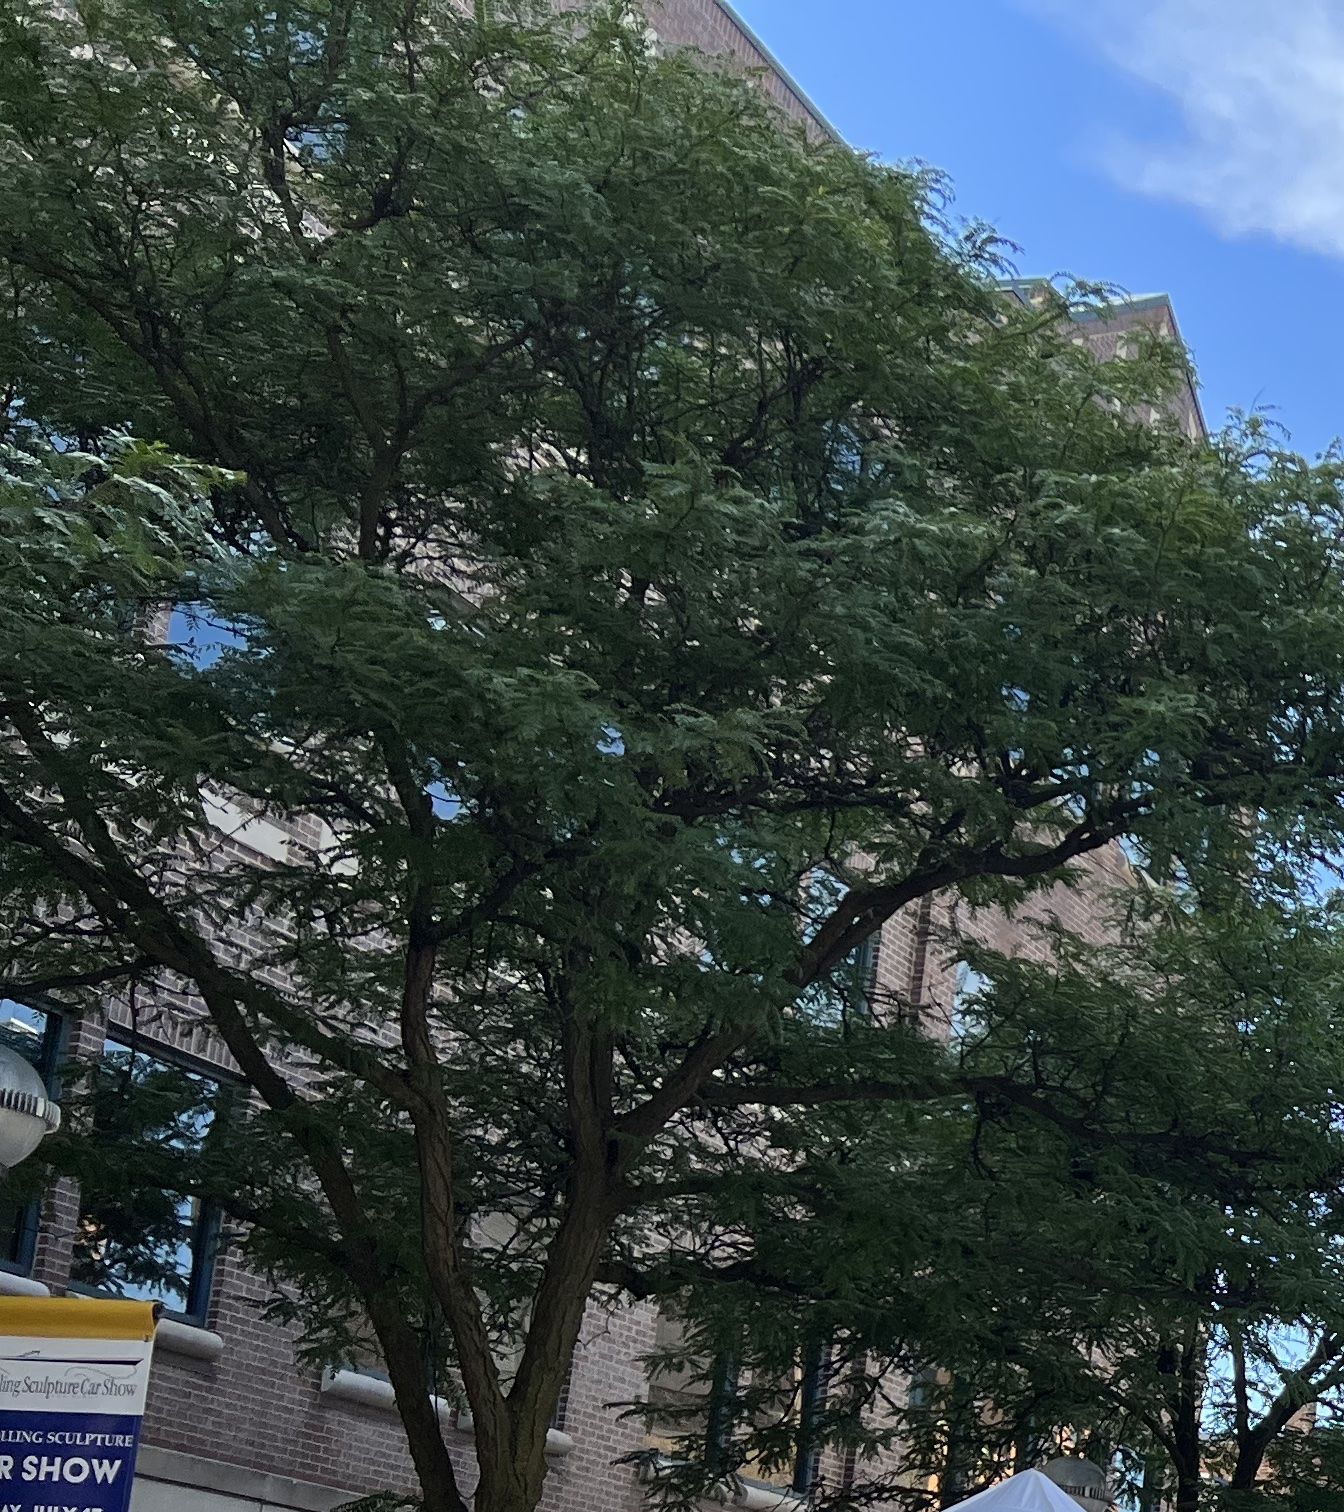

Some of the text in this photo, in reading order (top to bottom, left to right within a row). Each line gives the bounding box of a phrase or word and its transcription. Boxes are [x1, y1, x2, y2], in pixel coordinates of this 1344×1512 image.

[22, 1376, 79, 1399] Sculpture
[80, 1378, 100, 1396] Car
[102, 1378, 137, 1397] Show
[46, 1431, 134, 1447] SCULPTURE
[21, 1455, 122, 1485] SHOW
